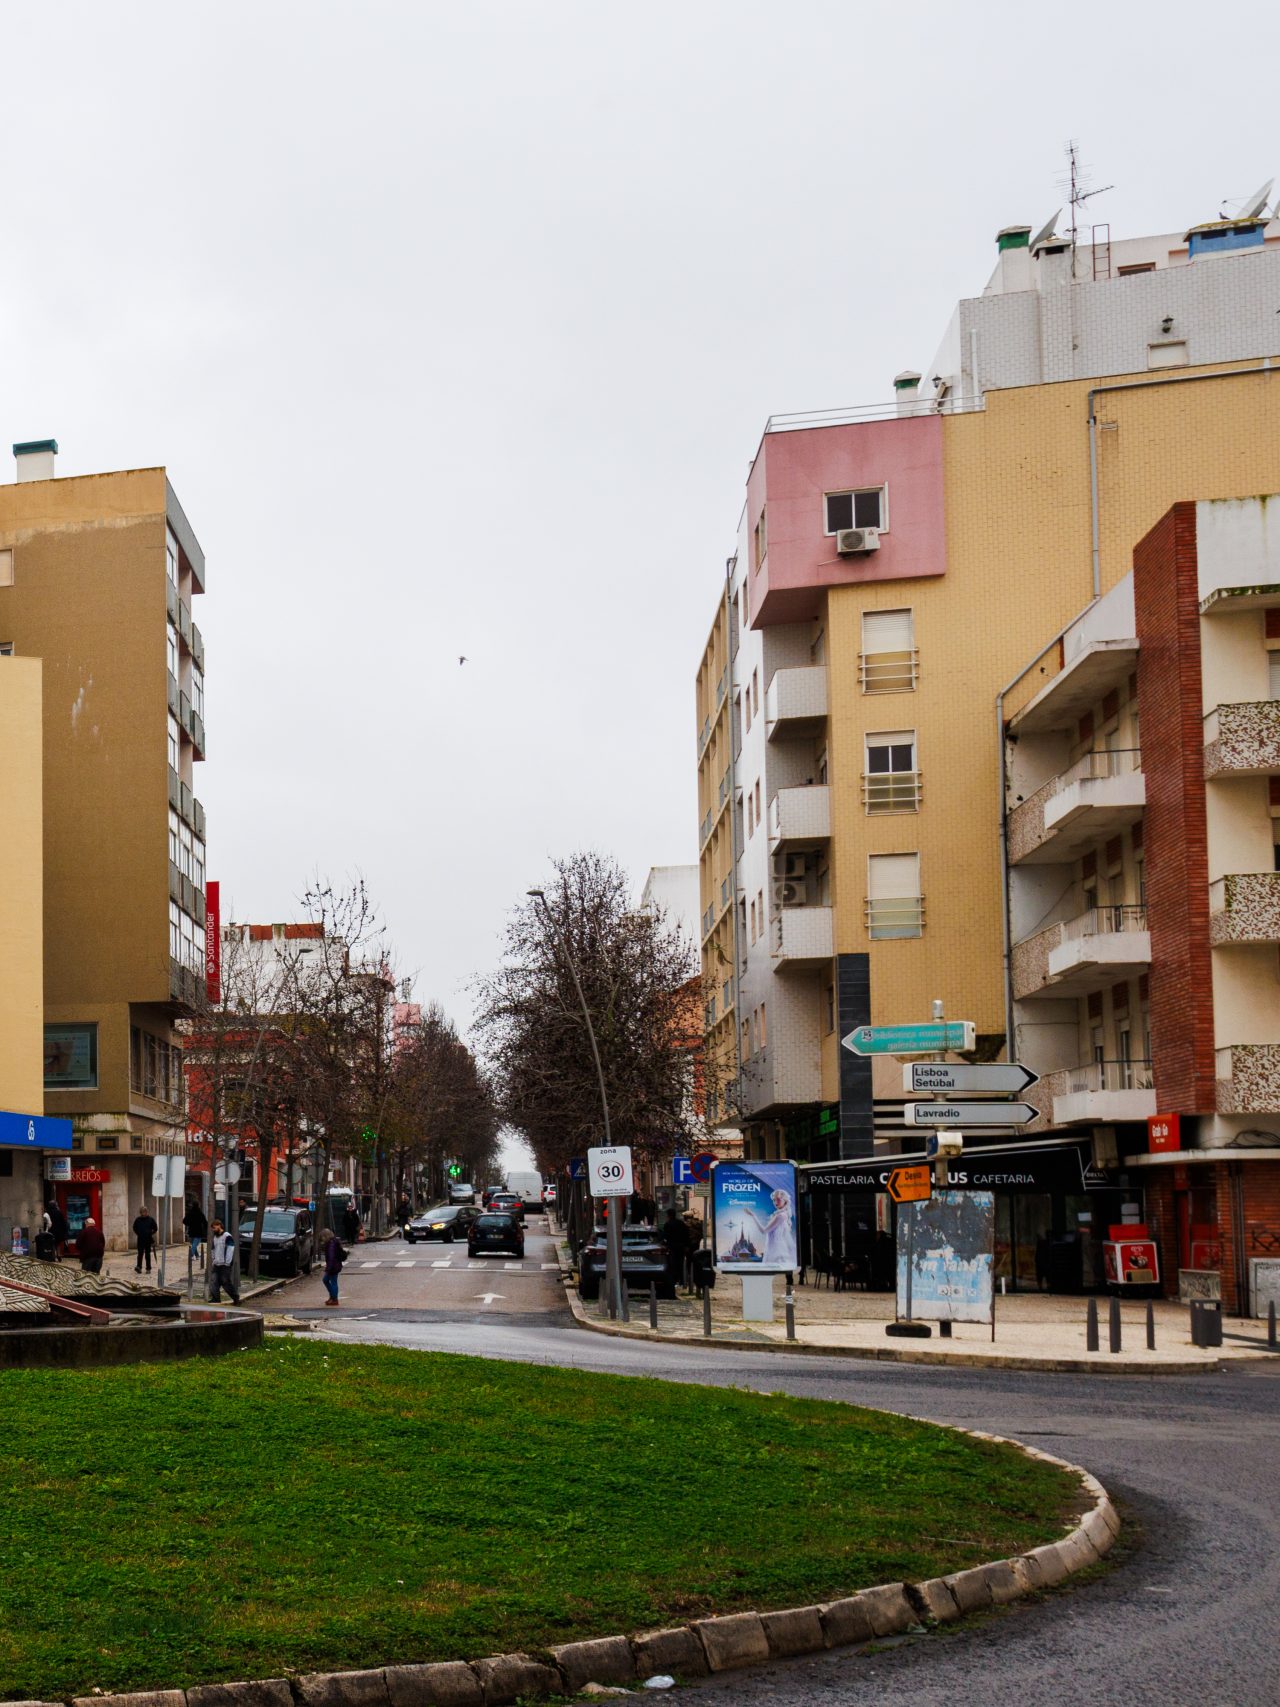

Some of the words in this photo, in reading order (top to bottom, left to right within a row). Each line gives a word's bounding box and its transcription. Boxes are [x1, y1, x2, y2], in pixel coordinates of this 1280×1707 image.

[206, 912, 215, 961] Santander
[872, 1029, 917, 1039] biblioteca
[918, 1028, 964, 1039] municipal
[887, 1041, 917, 1051] galeria
[919, 1039, 964, 1049] municipal
[915, 1067, 949, 1077] Lisboa
[915, 1079, 955, 1088] Setúbal
[916, 1108, 960, 1118] Lavradio
[70, 1170, 101, 1182] RREIOS
[601, 1165, 621, 1178] 30
[810, 1175, 875, 1185] PASTELARIA
[973, 1174, 1035, 1184] CAFETARIA
[722, 1183, 761, 1193] FROZEN
